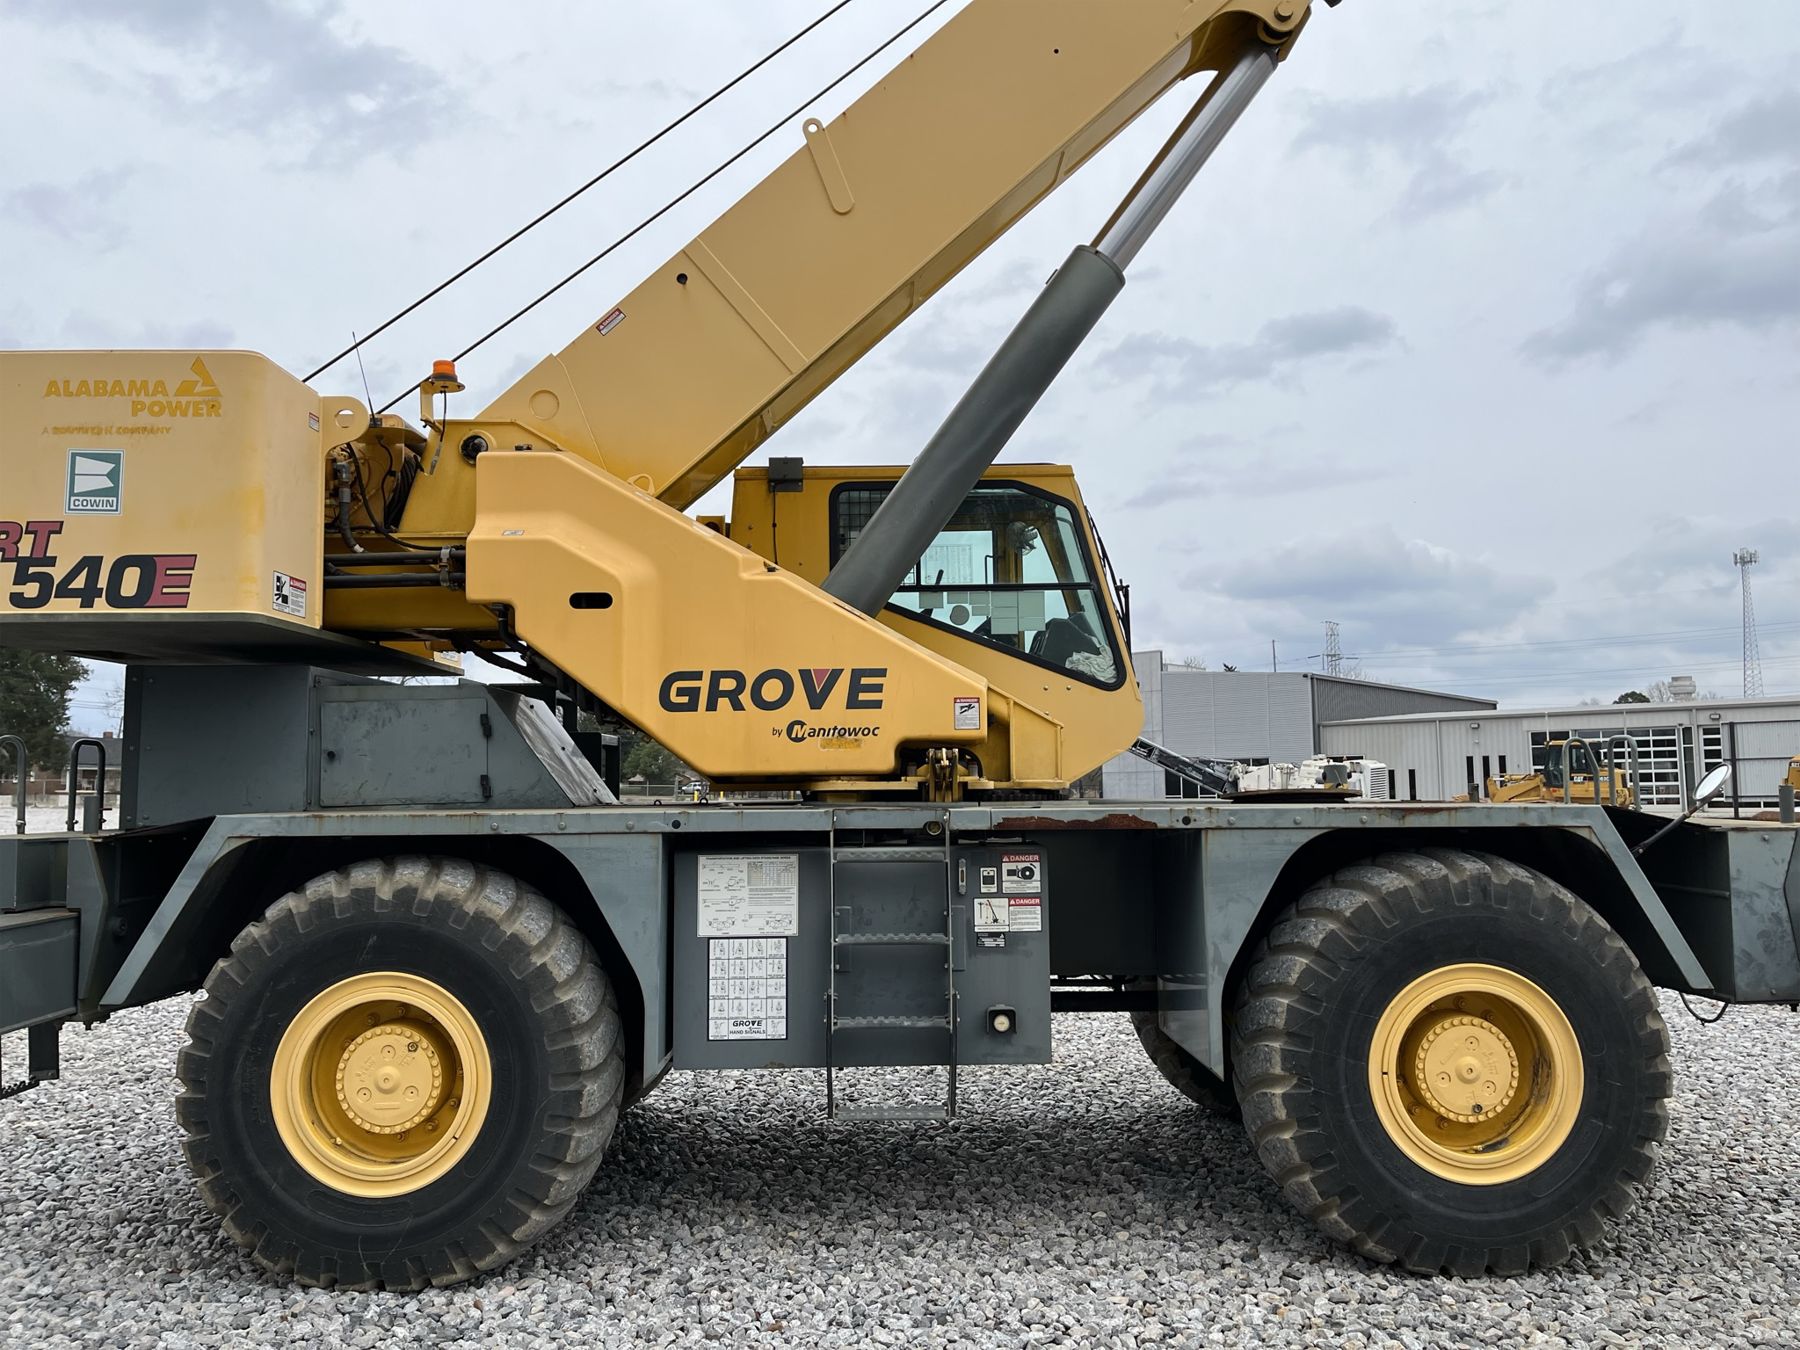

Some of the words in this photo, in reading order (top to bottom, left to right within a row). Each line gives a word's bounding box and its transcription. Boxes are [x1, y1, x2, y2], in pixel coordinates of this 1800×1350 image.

[44, 380, 168, 397] ALABAMA
[131, 400, 222, 417] POWER
[73, 498, 114, 508] COWIN
[9, 554, 197, 609] 540E
[658, 668, 888, 712] GROVE
[772, 726, 783, 738] by
[786, 719, 880, 743] Manitowoc
